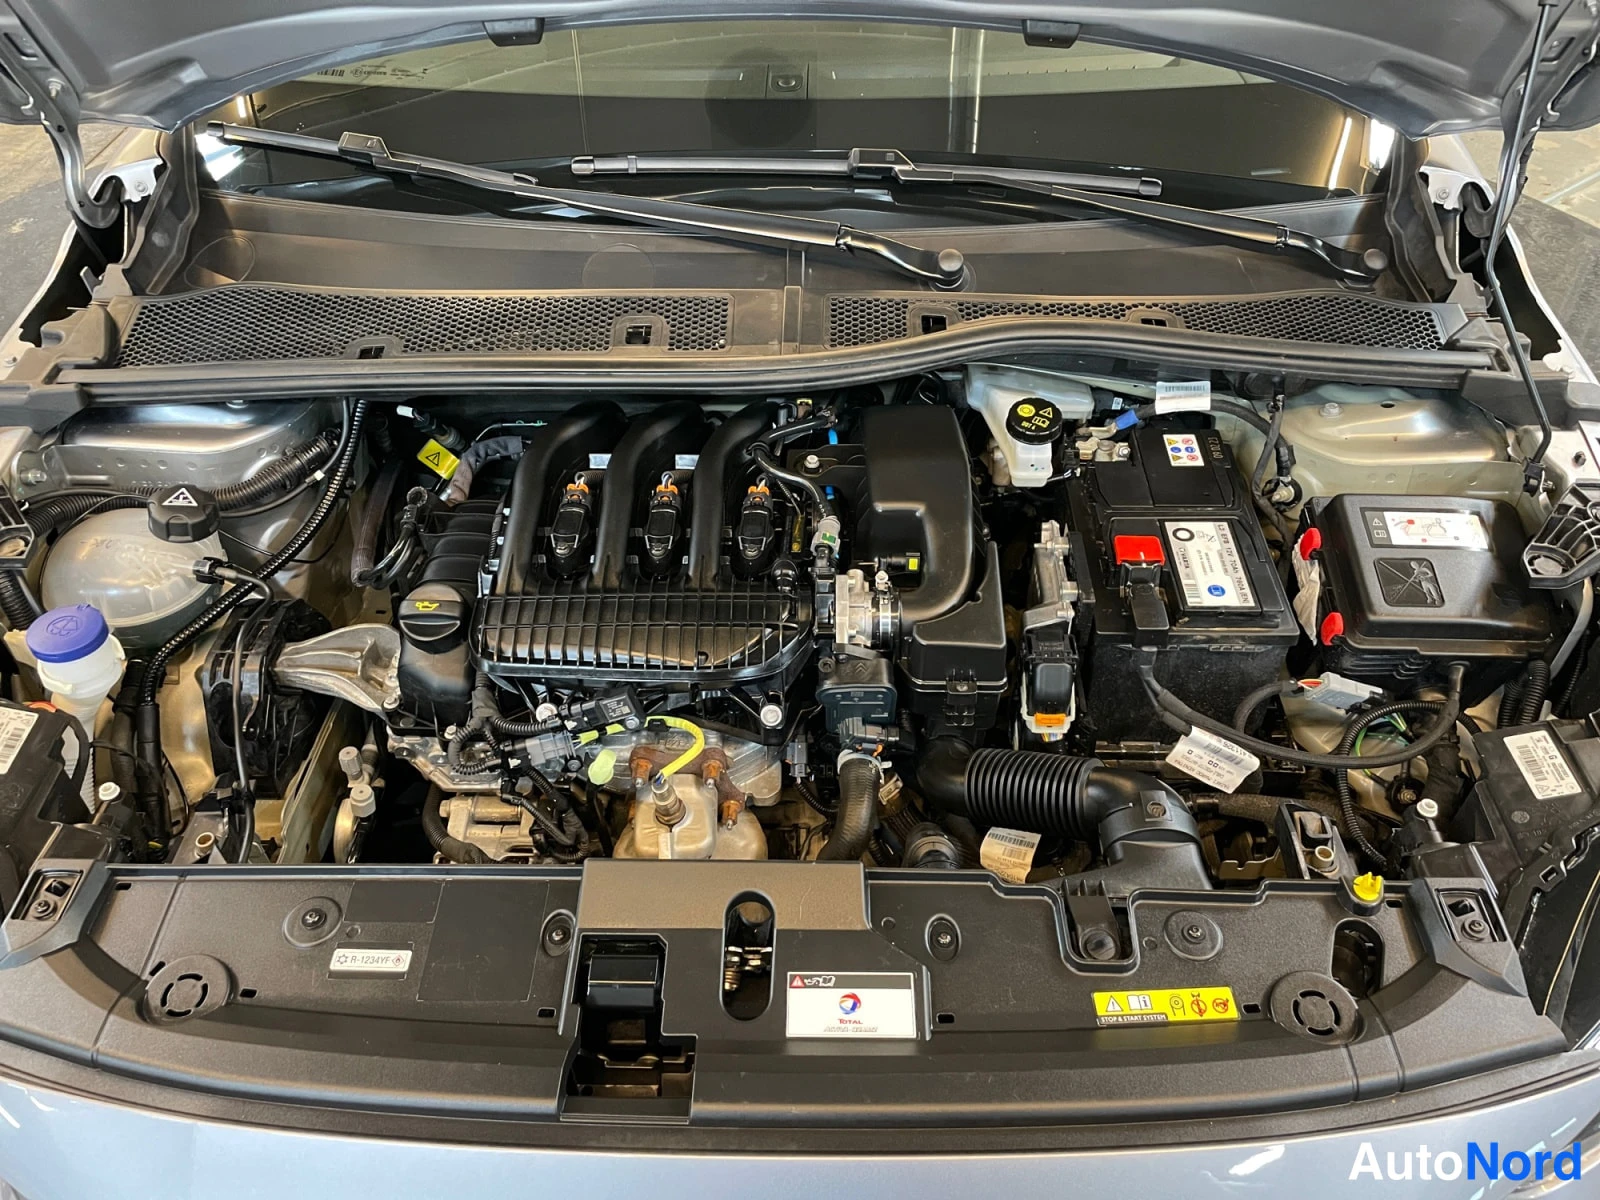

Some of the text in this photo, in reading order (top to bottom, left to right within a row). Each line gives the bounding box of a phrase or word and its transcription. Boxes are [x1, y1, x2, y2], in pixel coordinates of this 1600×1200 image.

[1225, 547, 1234, 558] 12V
[350, 955, 392, 965] R-1234YF
[1123, 1014, 1142, 1022] START
[1142, 1013, 1167, 1021] SYSTEM
